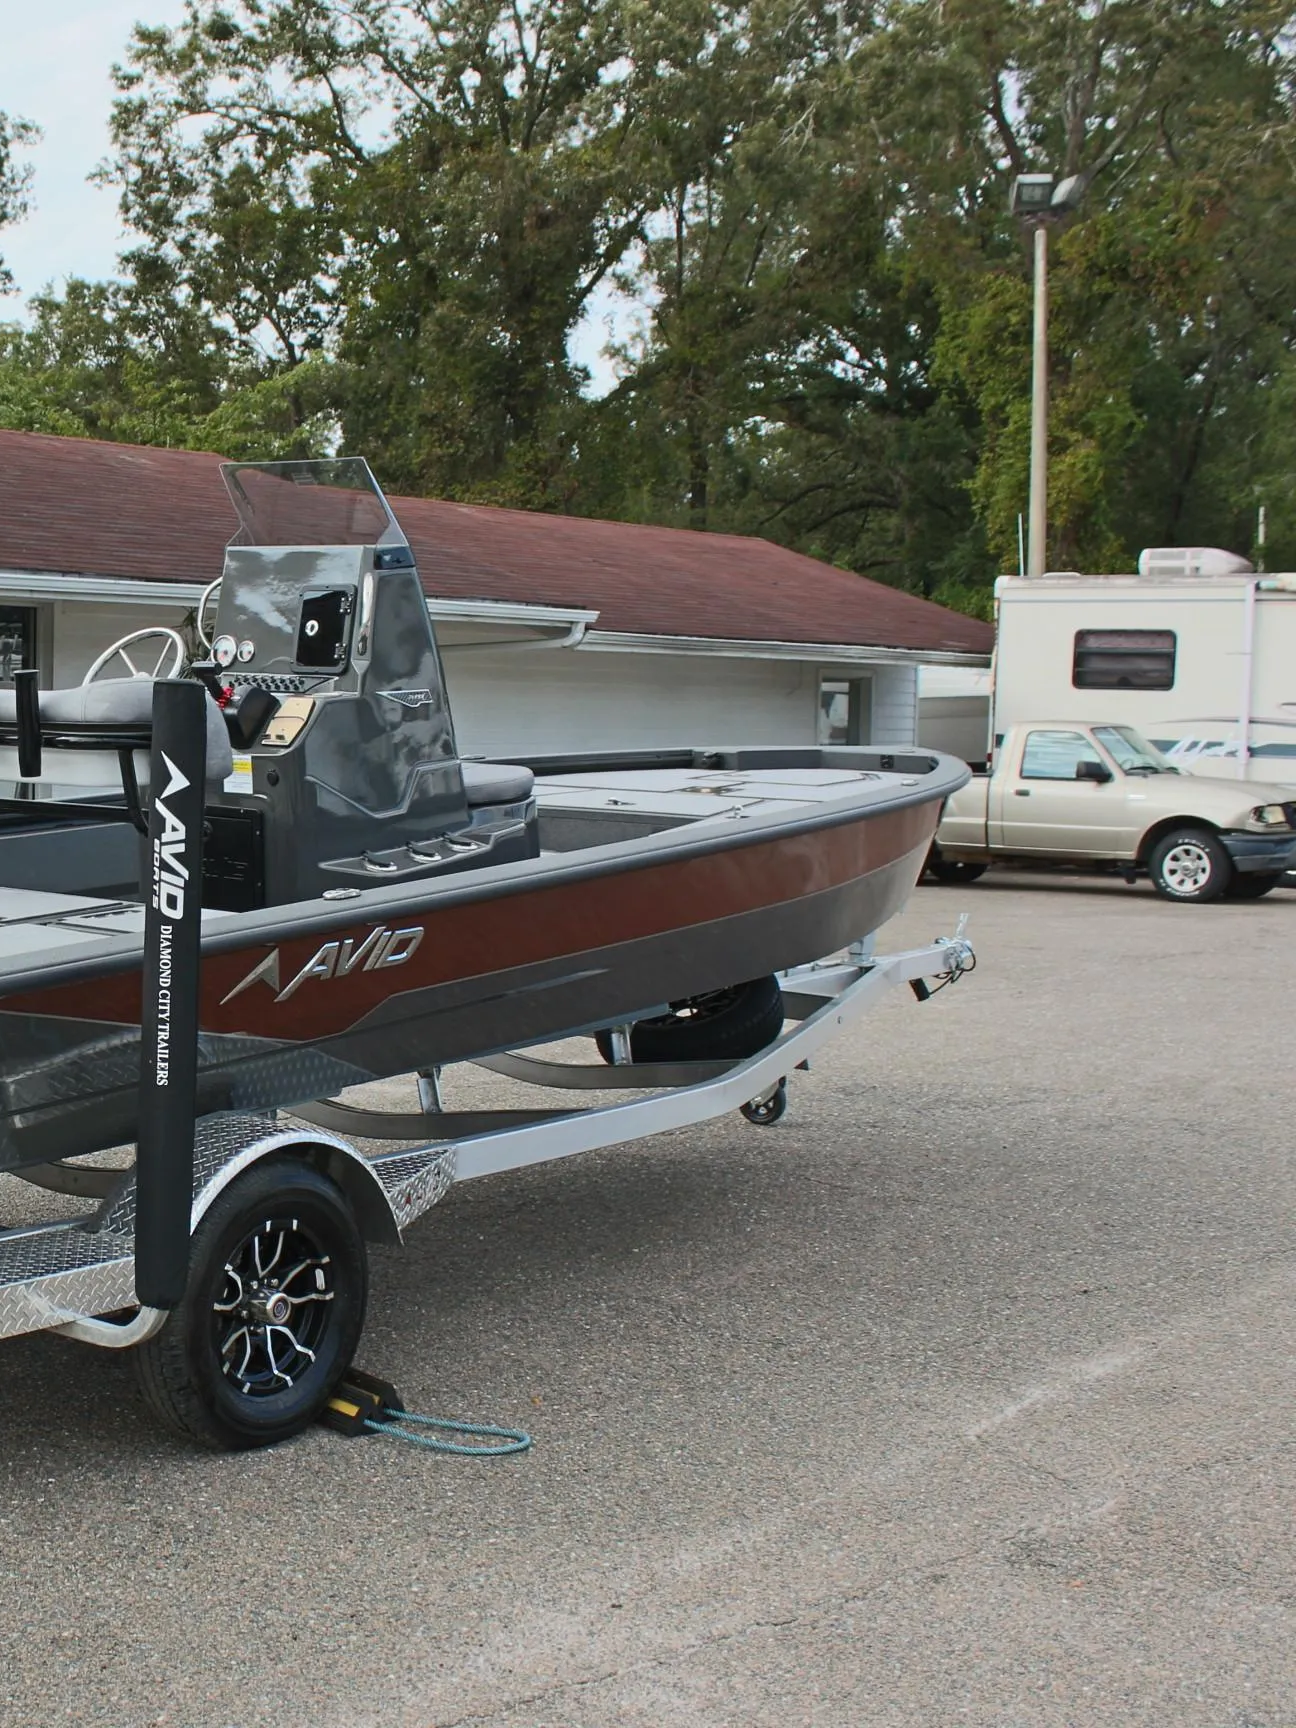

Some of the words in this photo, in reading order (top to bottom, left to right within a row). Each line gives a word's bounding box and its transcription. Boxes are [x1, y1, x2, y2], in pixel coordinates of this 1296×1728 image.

[153, 838, 161, 910] SPORTS
[155, 797, 189, 920] AVID
[159, 924, 173, 988] DIAMOND
[273, 926, 425, 1003] AVID
[158, 989, 171, 1021] CITY
[156, 1023, 170, 1087] TRAILERS
